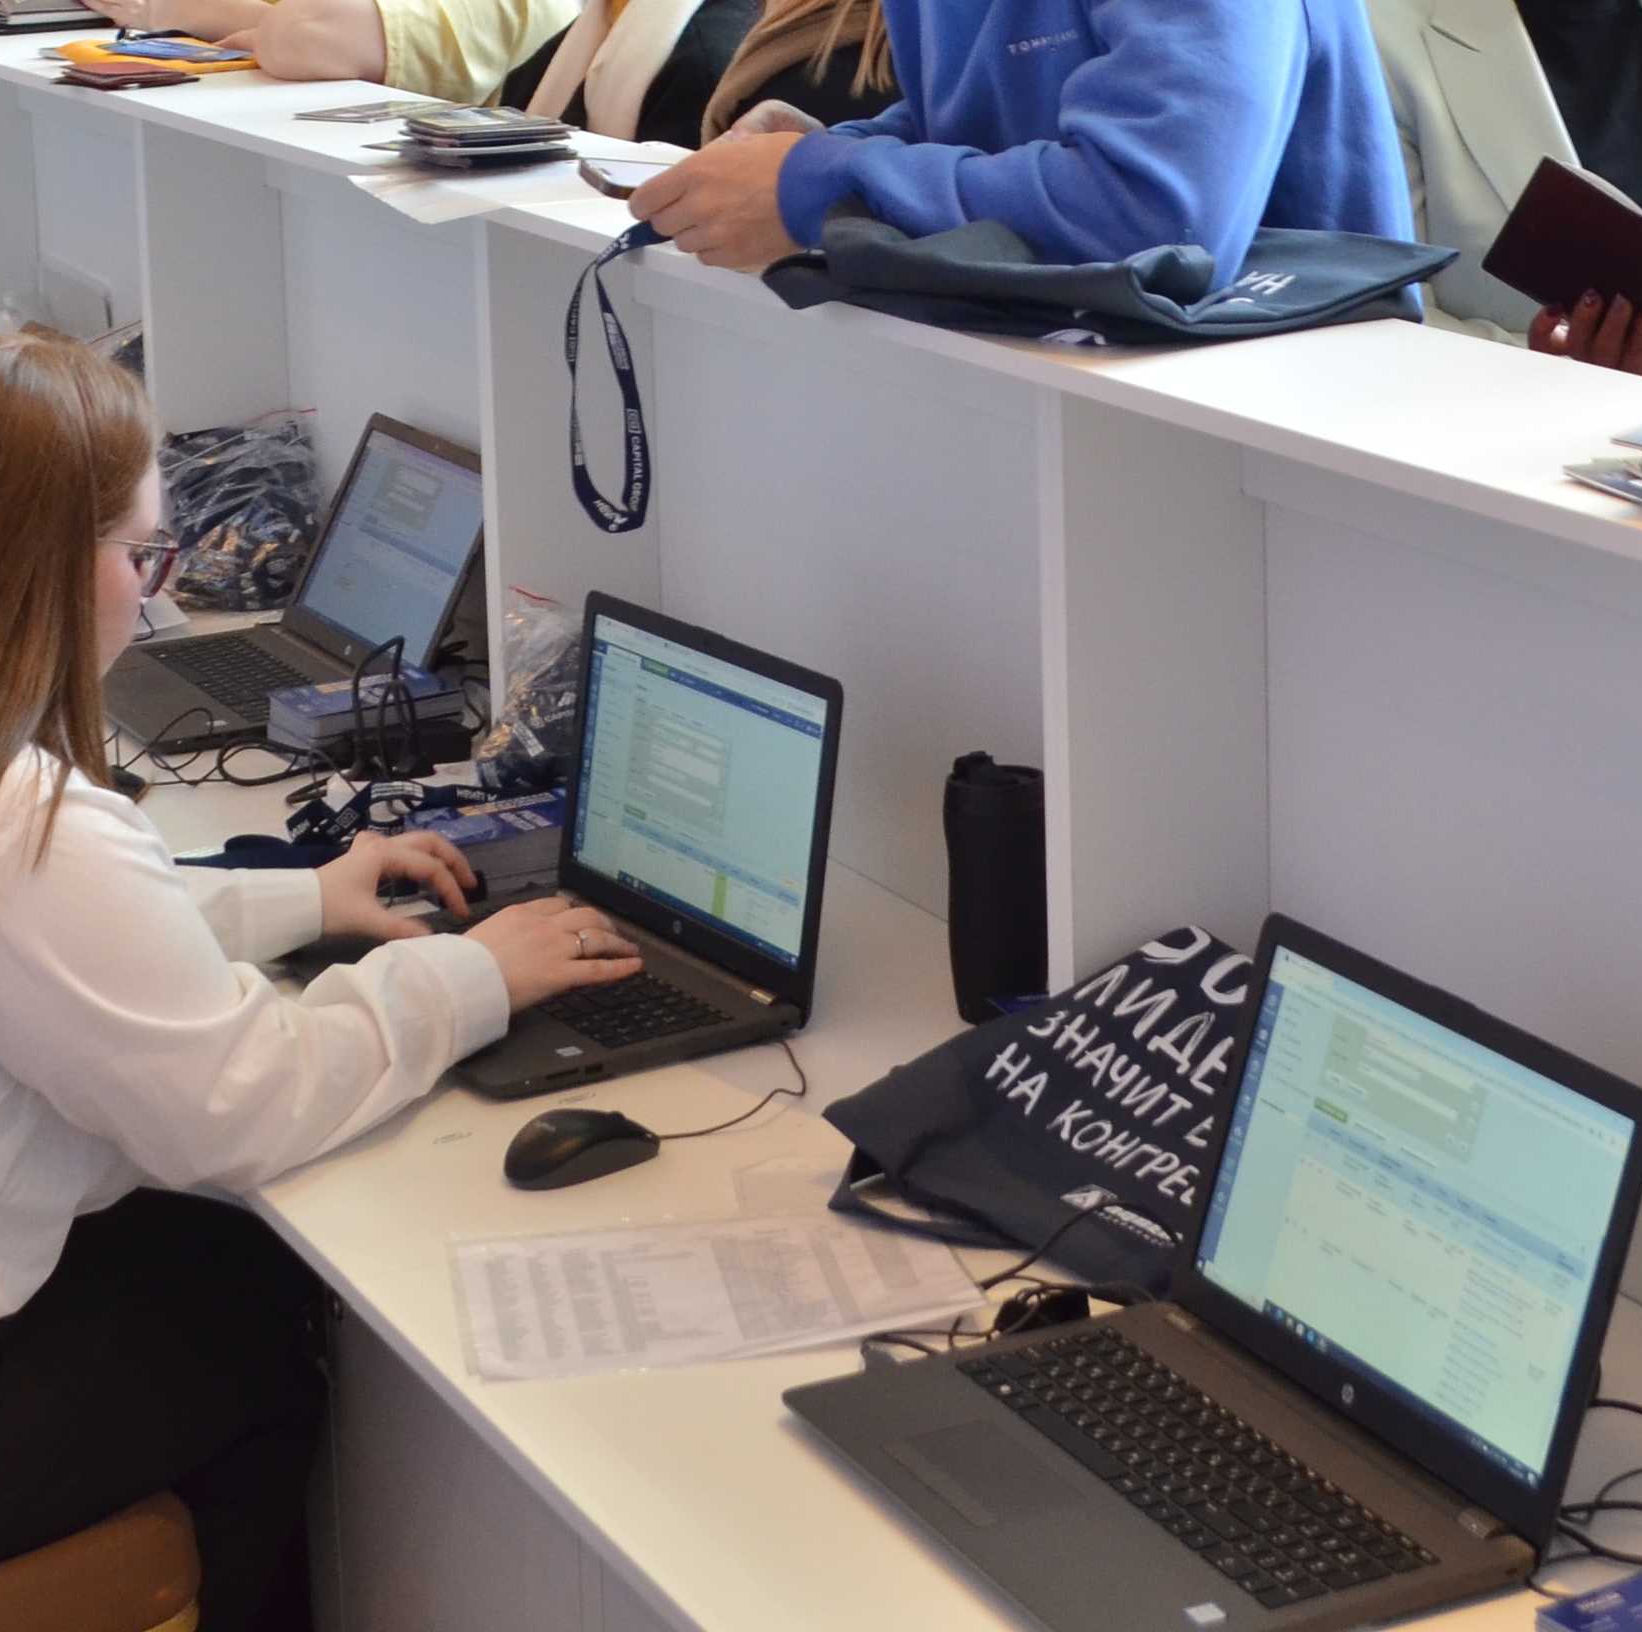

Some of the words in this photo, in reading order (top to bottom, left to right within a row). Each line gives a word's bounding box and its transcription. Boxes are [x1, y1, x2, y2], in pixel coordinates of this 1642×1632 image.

[630, 435, 646, 484] CAPITAL
[984, 1041, 1051, 1117] НА
[1026, 1009, 1196, 1129] ЗНАЧИТ
